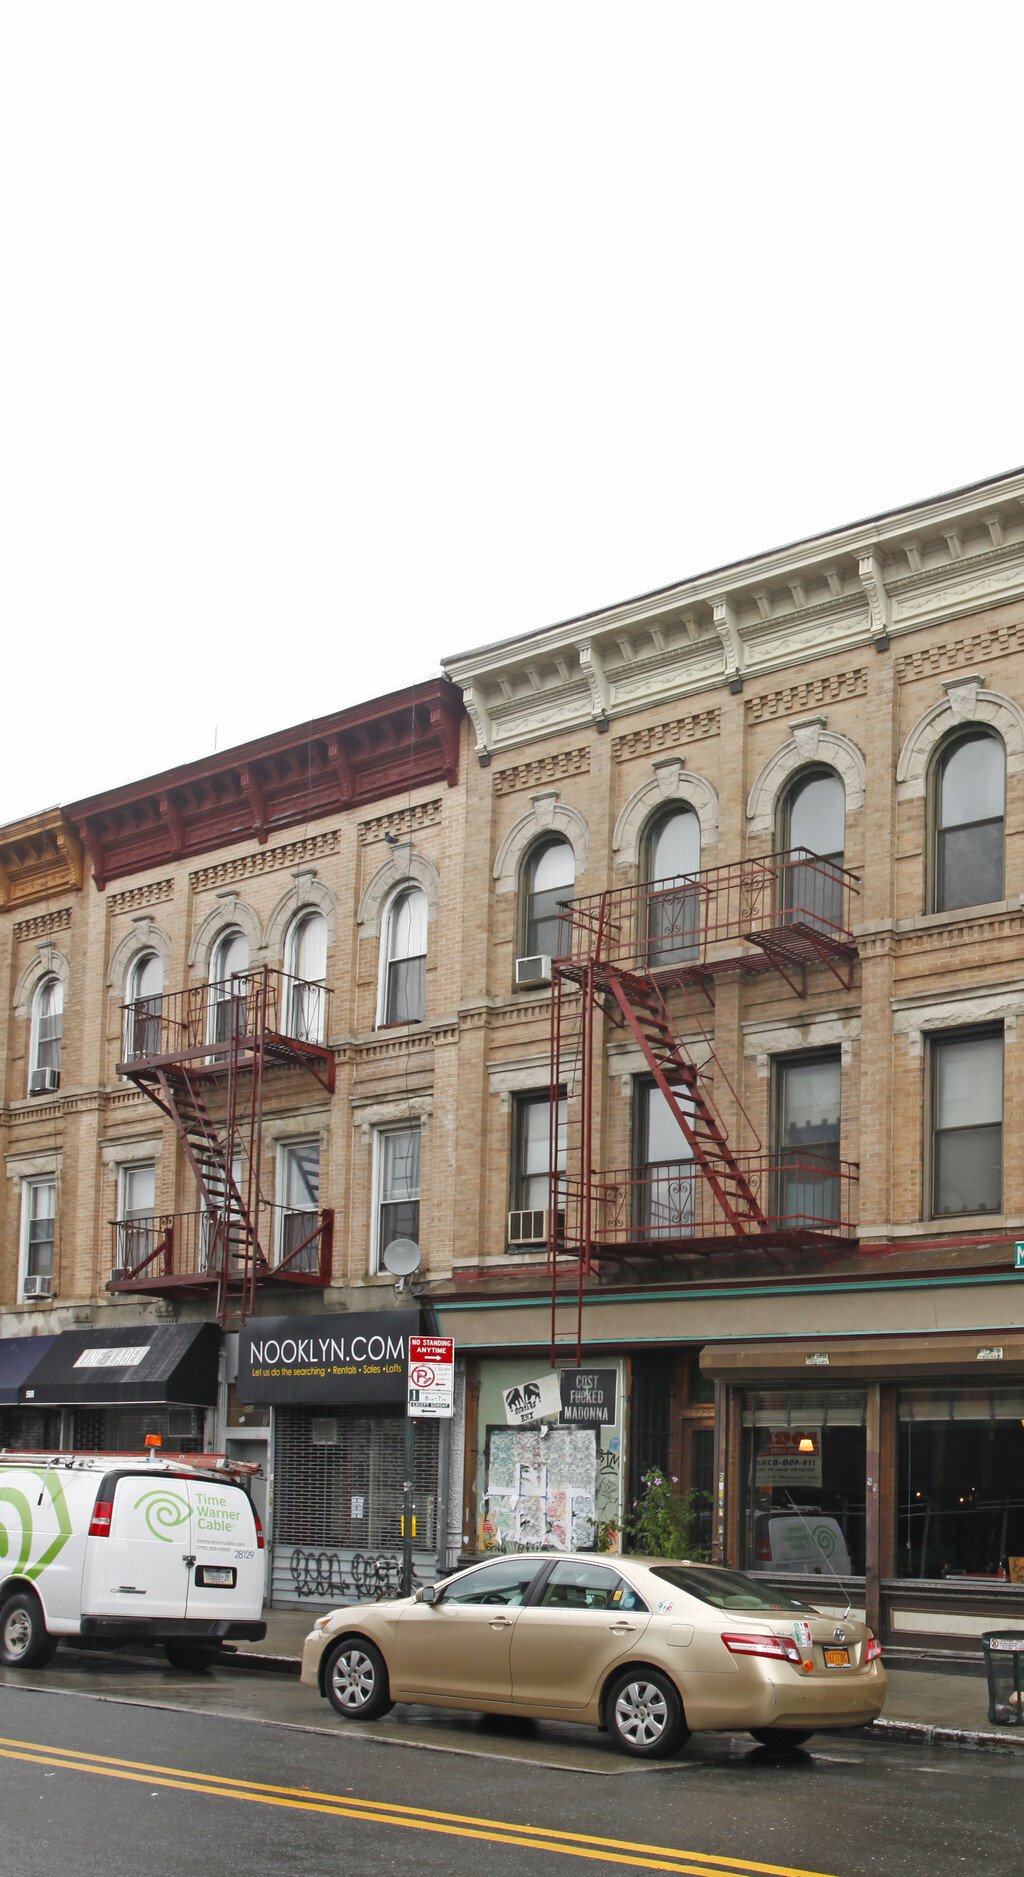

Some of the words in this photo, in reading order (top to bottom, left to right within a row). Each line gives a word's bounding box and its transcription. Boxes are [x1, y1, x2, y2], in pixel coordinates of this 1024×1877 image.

[250, 1336, 405, 1364] NOOKLYN.COM
[422, 1339, 451, 1347] STANDING
[252, 1368, 262, 1377] Let
[271, 1368, 281, 1376] do
[281, 1367, 292, 1376] the
[293, 1366, 326, 1377] searching
[332, 1365, 357, 1375] Rentals
[363, 1364, 381, 1374] Sales
[576, 1375, 599, 1389] COST
[570, 1390, 604, 1404] FUCKED
[564, 1406, 609, 1421] MADONNA
[195, 1493, 227, 1507] Time
[196, 1506, 241, 1521] Warner
[197, 1518, 233, 1532] Cable
[234, 1550, 255, 1559] 28129
